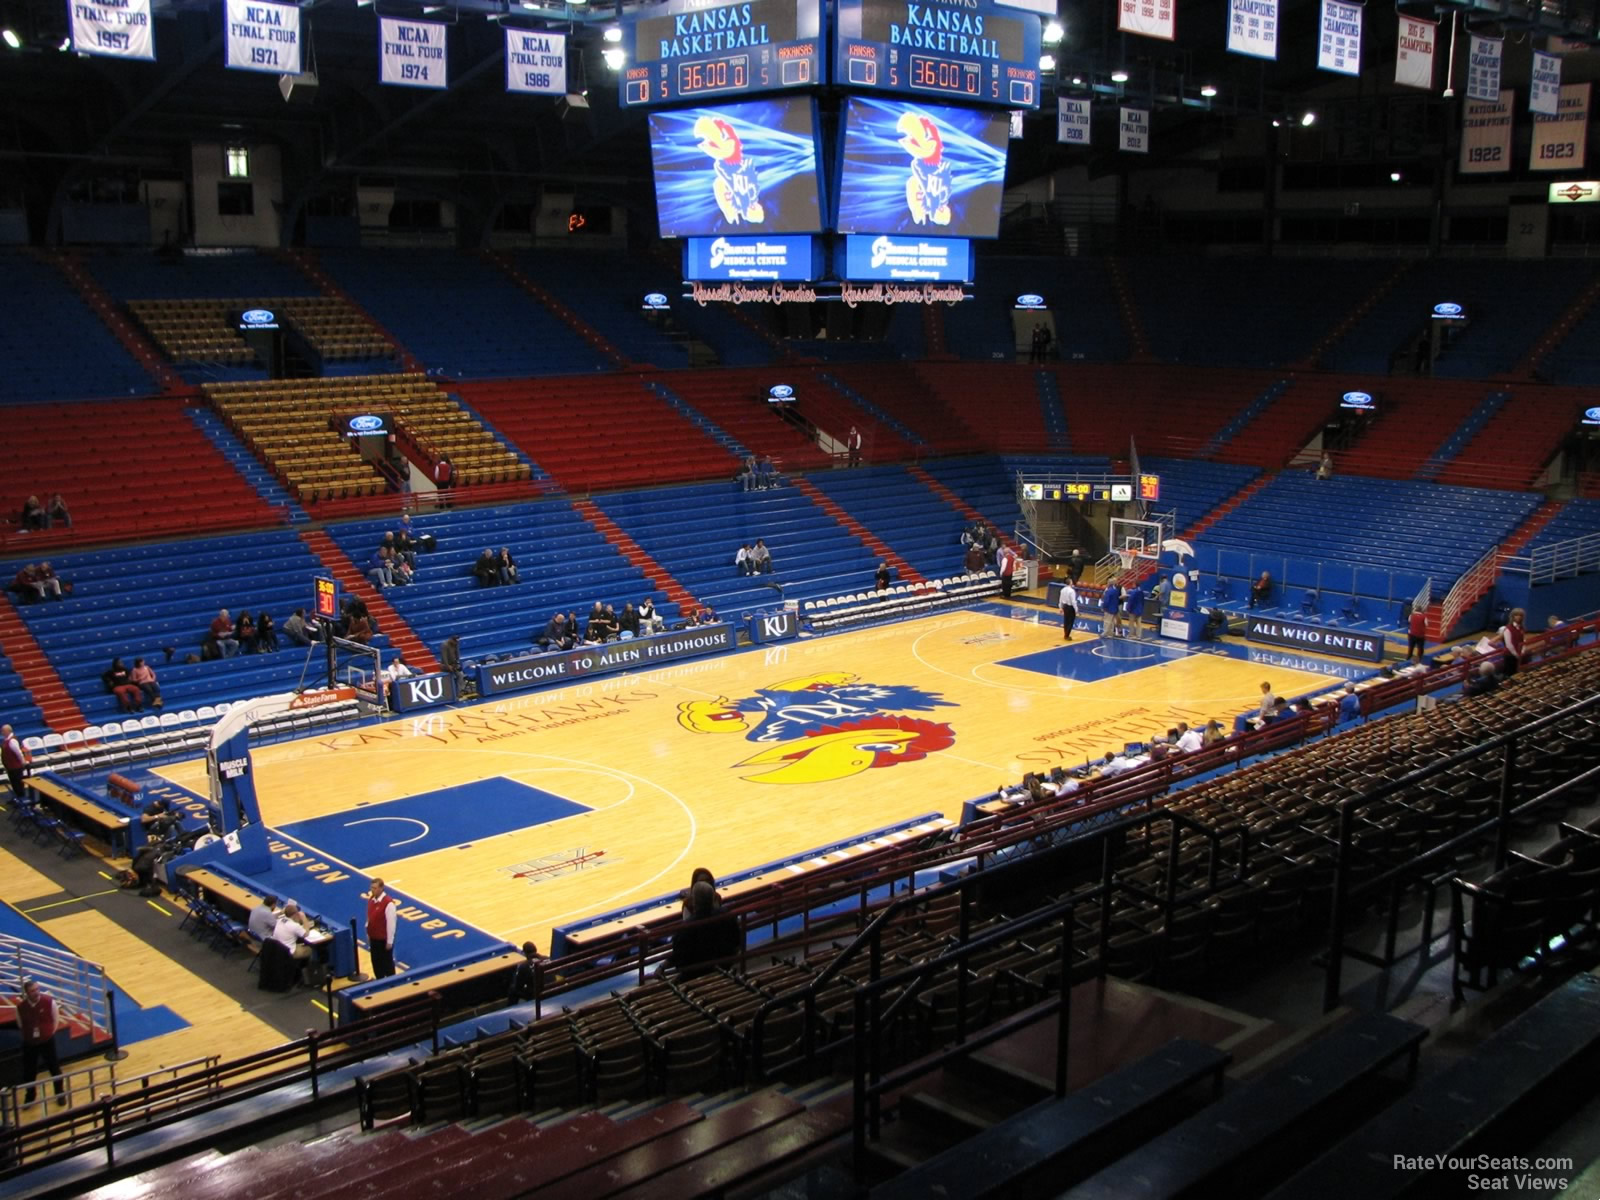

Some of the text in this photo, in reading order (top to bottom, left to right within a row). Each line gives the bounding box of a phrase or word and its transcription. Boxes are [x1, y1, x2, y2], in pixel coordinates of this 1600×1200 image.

[75, 6, 147, 26] FINAL FOUR
[246, 6, 281, 26] NCAA
[1233, 0, 1275, 18] CHAMPIONS
[1326, 3, 1358, 22] BIG EIGHT
[675, 4, 751, 36] KANSAS
[908, 4, 983, 36] KANSAS
[1324, 17, 1359, 37] CHAMPIONS
[232, 23, 297, 44] FINAL FOUR
[398, 26, 430, 44] NCAA
[1408, 23, 1425, 39] BIG 12
[96, 31, 130, 50] 1957
[522, 36, 551, 53] NCAA
[661, 25, 769, 58] BASKETBALL
[890, 25, 999, 59] BASKETBALL
[1400, 36, 1432, 54] CHAMPIONS
[251, 47, 279, 66] 1971
[385, 43, 443, 60] FINAL FOUR
[779, 45, 813, 58] ARKANSAS
[849, 44, 875, 58] KANSAS
[511, 52, 563, 69] FINAL FOUR
[401, 64, 428, 80] 1974
[626, 67, 649, 80] KANSAS
[735, 66, 743, 86] 0
[800, 60, 808, 81] 0
[866, 62, 874, 83] 0
[890, 67, 897, 85] 5
[524, 72, 550, 88] 1986
[661, 80, 668, 98] 5
[967, 73, 975, 93] 0
[992, 80, 999, 98] 5
[640, 81, 648, 101] 0
[1024, 82, 1031, 102] 0
[1066, 102, 1082, 113] NCAA
[1469, 104, 1507, 114] NATIONAL
[1061, 113, 1075, 123] FINAL
[1127, 112, 1141, 122] NCAA
[1463, 116, 1510, 128] CHAMPIONS
[1067, 128, 1083, 140] 2008
[1127, 137, 1141, 148] 2012
[1468, 146, 1502, 162] 1922
[1539, 143, 1575, 159] 1923
[1520, 223, 1535, 234] 22
[692, 281, 816, 306] Russell Stover Candies
[842, 282, 883, 308] Russell
[885, 282, 923, 305] Stover
[1067, 485, 1089, 493] 36:00
[1140, 476, 1157, 484] 36:00
[1142, 485, 1155, 497] 30
[319, 579, 334, 594] 36:00
[320, 593, 333, 613] 30
[764, 614, 788, 637] KU
[1253, 623, 1374, 652] ALL WHO ENTER
[492, 633, 727, 686] WELCOME TO ALLEN FIELDHOUSE
[409, 677, 443, 703] KU
[245, 711, 259, 722] KU
[424, 689, 659, 745] JAYHAWKS
[1034, 706, 1151, 742] Allen Fieldhouse
[476, 708, 631, 744] Allen Fieldhouse
[1016, 705, 1206, 765] JAYHAWKS
[220, 757, 248, 772] MUSCLE
[226, 768, 244, 779] MILK
[148, 786, 211, 819] Court
